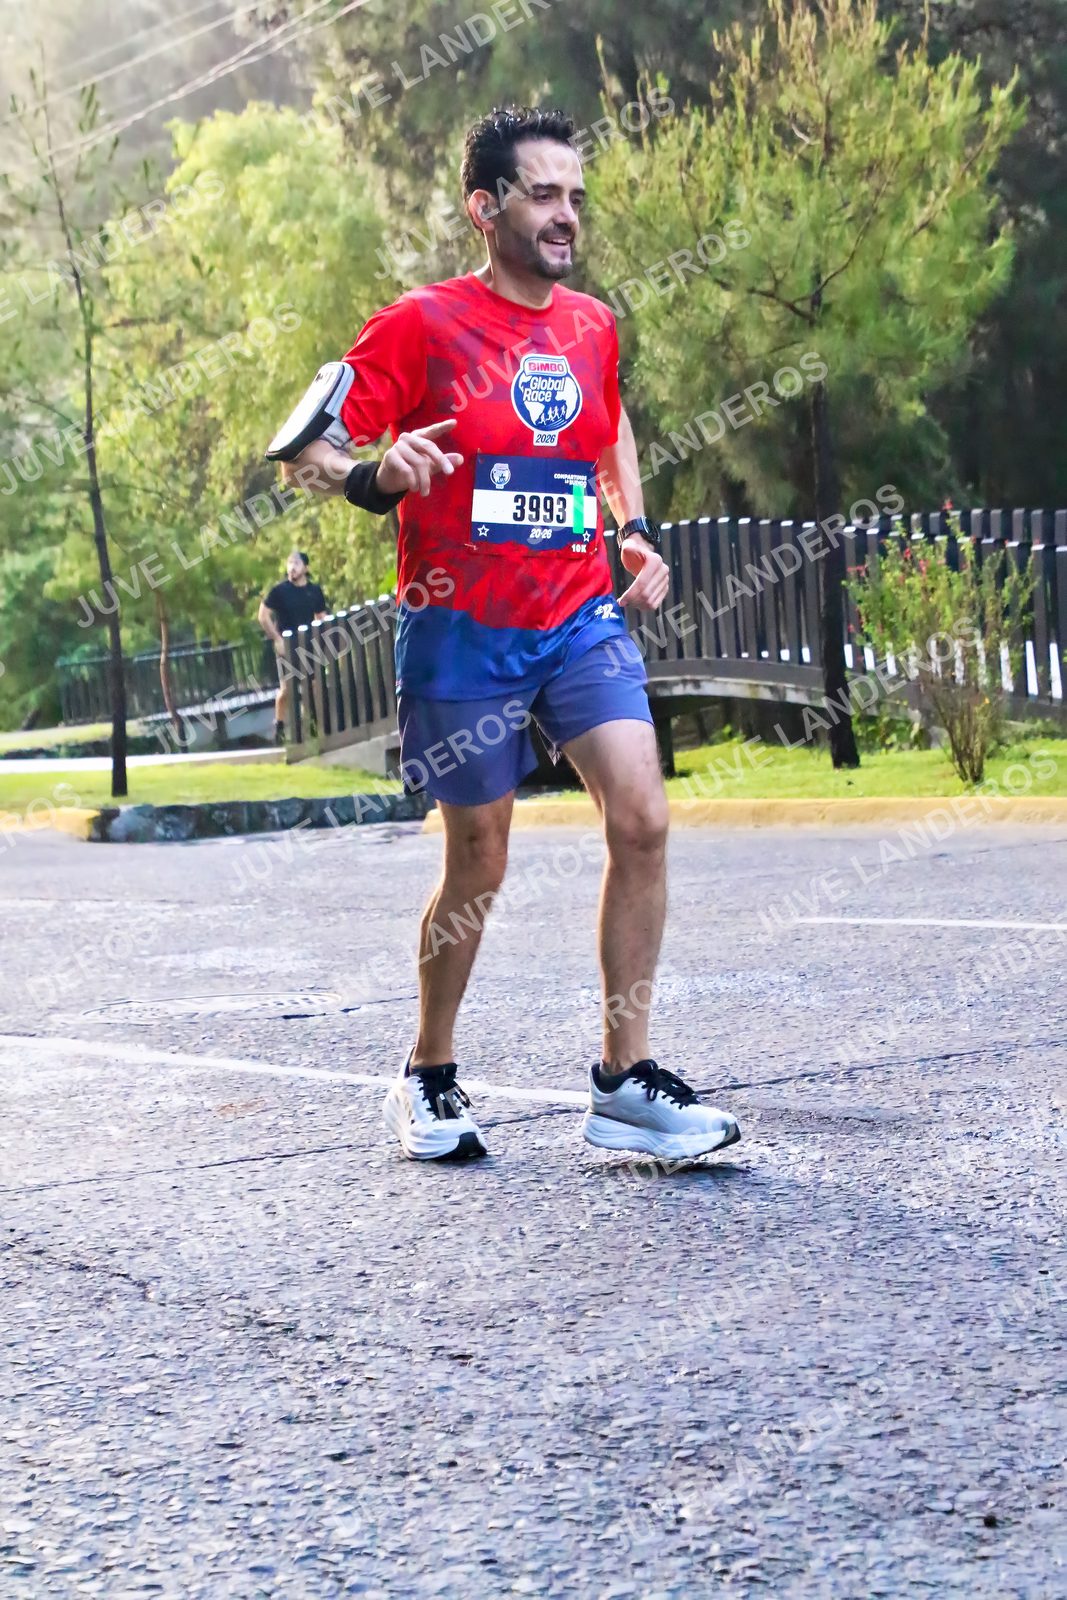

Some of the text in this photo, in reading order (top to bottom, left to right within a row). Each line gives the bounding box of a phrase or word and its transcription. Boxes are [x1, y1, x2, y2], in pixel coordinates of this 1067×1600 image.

[529, 376, 566, 391] Global
[523, 388, 552, 402] Race
[535, 433, 557, 444] 2026
[512, 494, 567, 524] 3993
[571, 543, 587, 553] 10K
